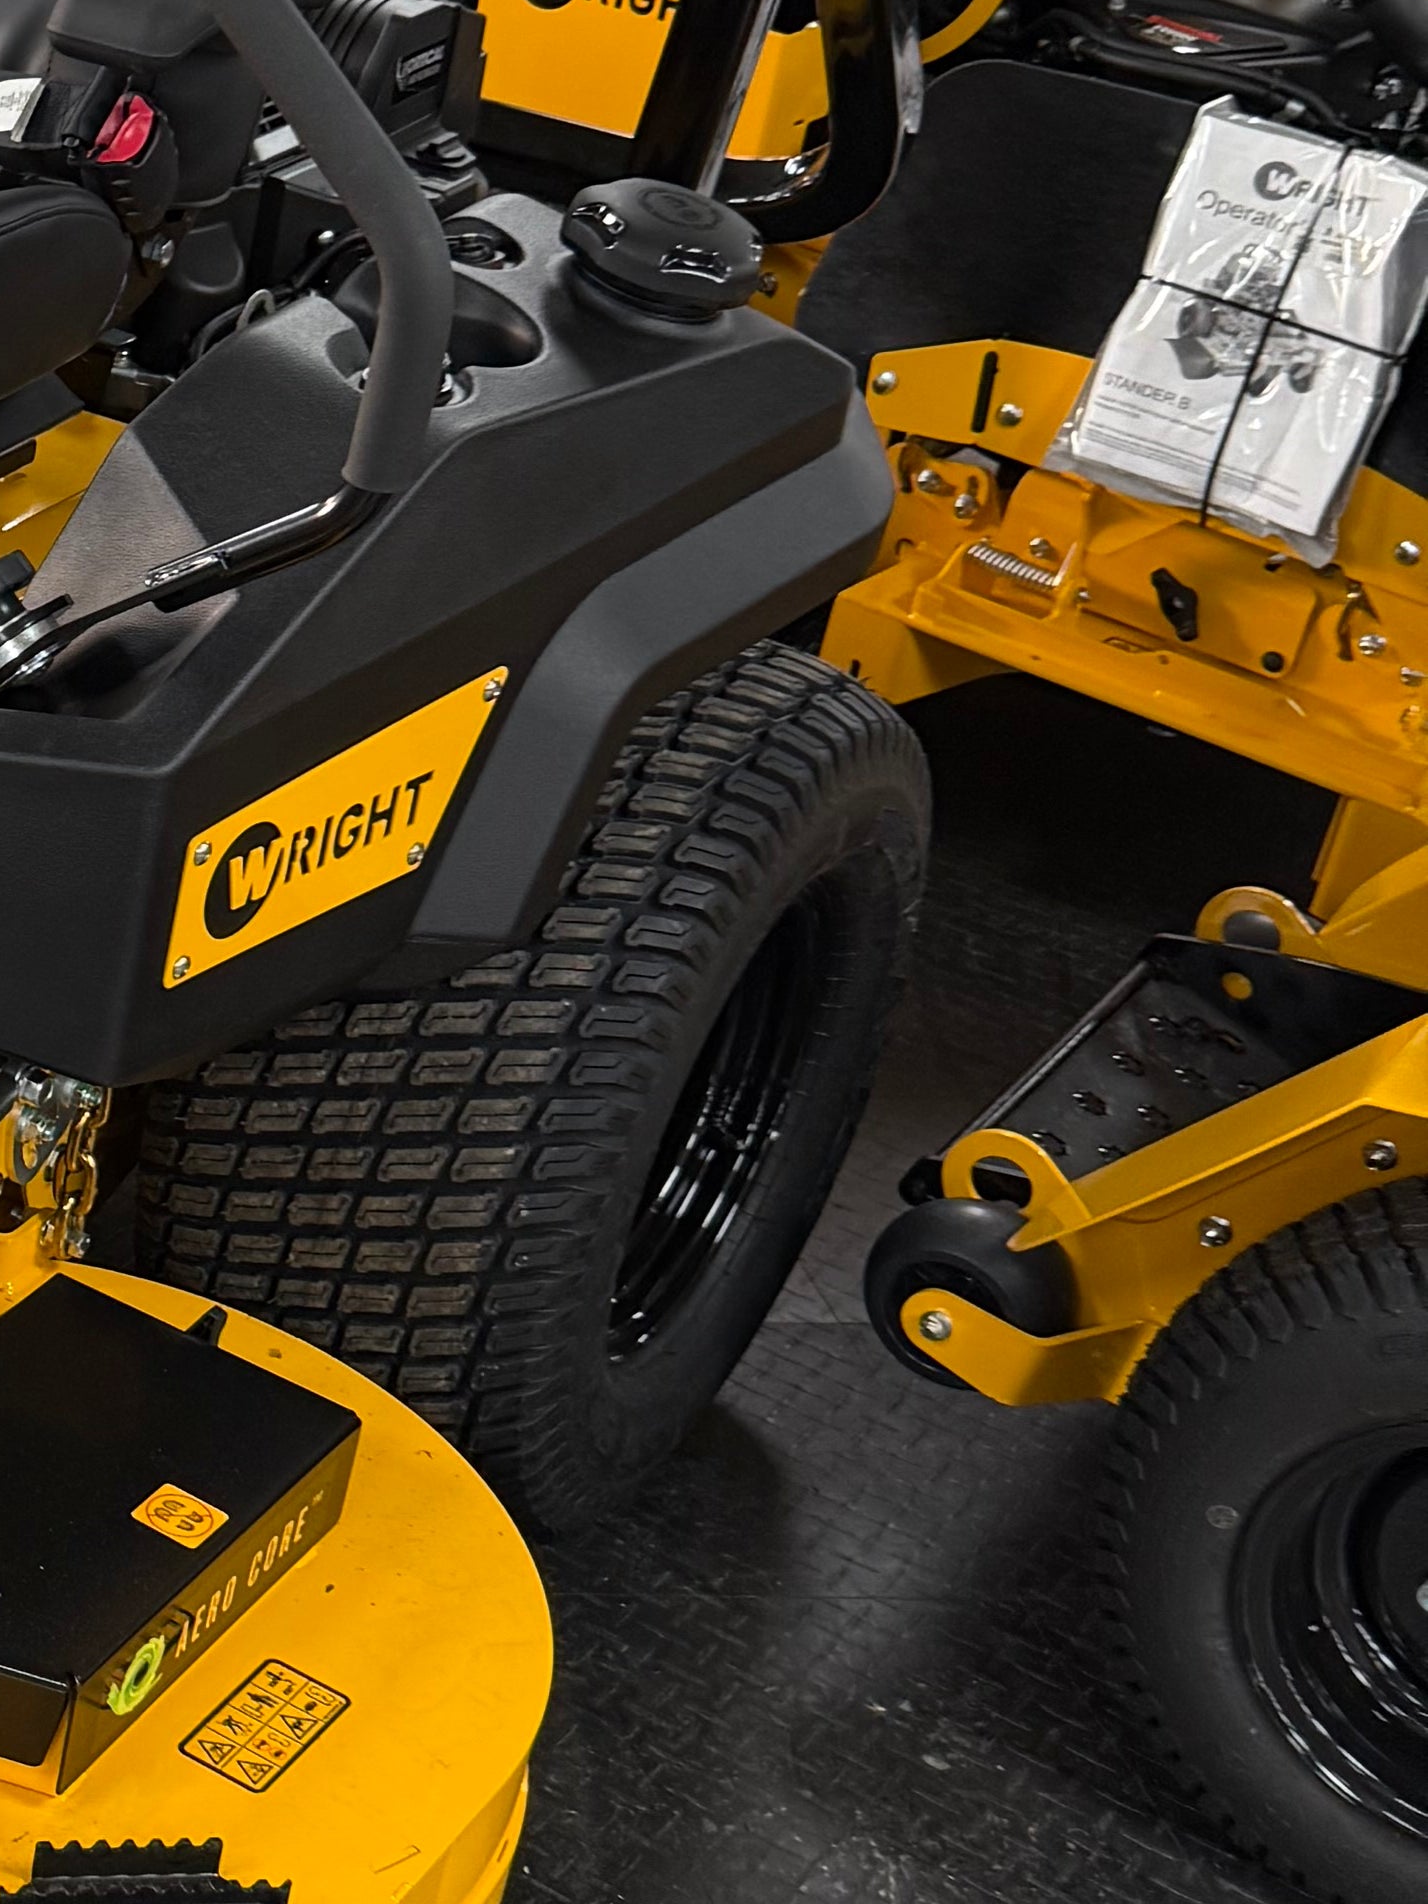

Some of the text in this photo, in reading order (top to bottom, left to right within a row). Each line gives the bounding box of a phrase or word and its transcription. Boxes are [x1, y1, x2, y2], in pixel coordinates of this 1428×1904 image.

[1103, 372, 1193, 410] STANDER B
[210, 770, 435, 932] WRIGHT
[174, 1575, 237, 1658] AERO
[247, 1505, 309, 1587] CORE
